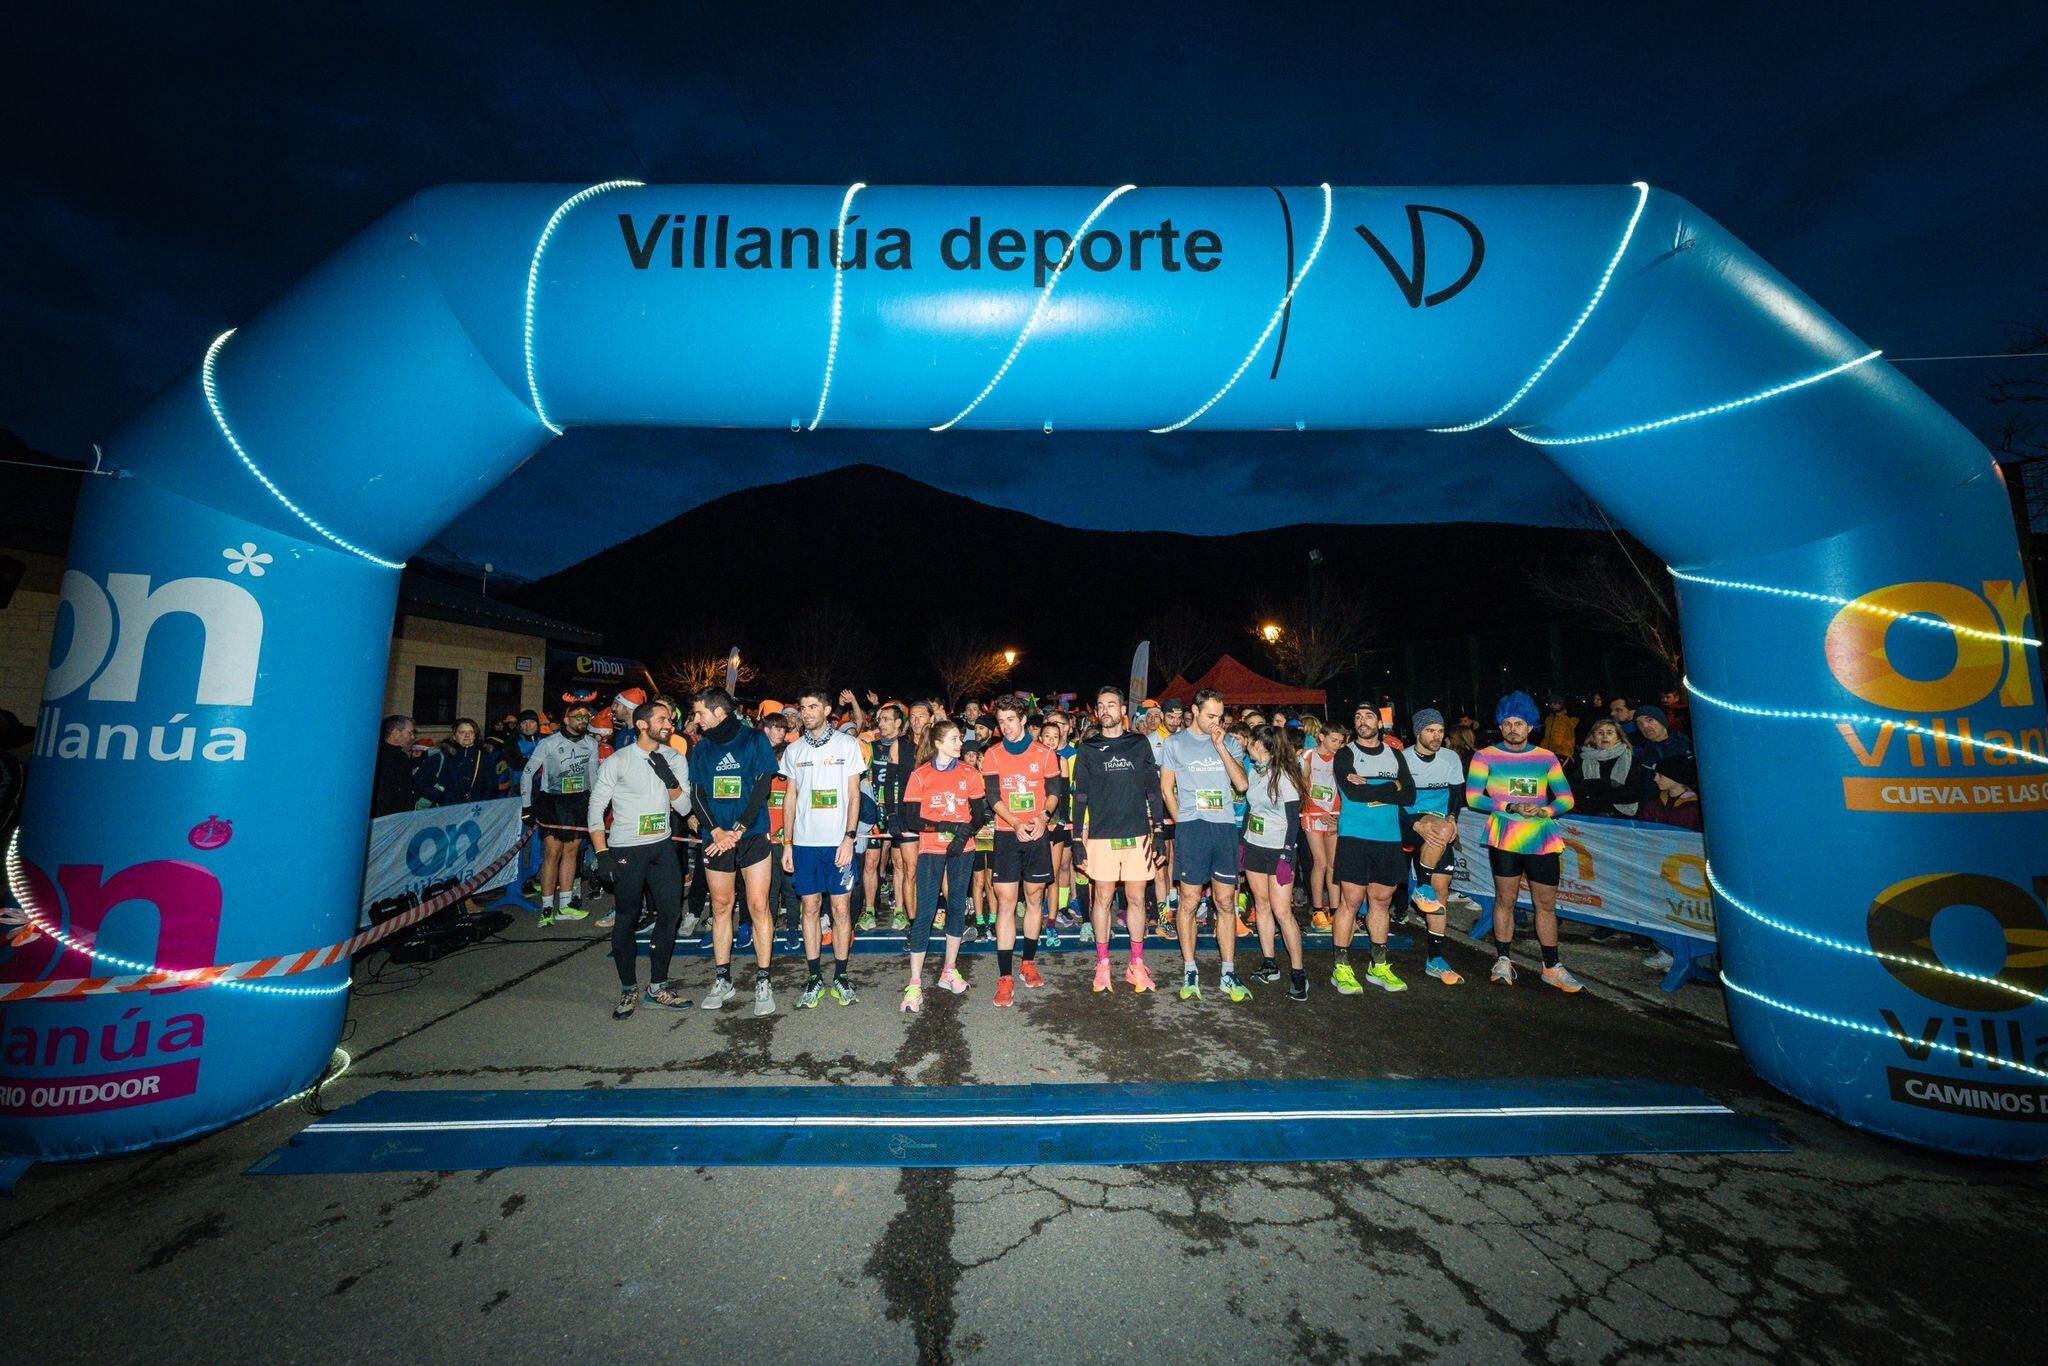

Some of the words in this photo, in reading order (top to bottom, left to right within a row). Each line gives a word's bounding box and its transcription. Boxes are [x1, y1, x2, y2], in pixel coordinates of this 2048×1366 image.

[618, 214, 912, 270] Villanúa
[940, 214, 1223, 288] deporte
[576, 655, 624, 676] embou
[32, 707, 248, 762] illanúa
[1835, 717, 2048, 768] Villan
[716, 763, 741, 771] adidas
[1881, 786, 1968, 805] CUEVA
[1973, 785, 2003, 804] DE
[2008, 783, 2040, 804] LAS
[407, 820, 482, 877] on
[1660, 853, 1714, 899] o
[1866, 872, 2048, 1013] o
[31, 1075, 160, 1108] OUTDOOR
[1905, 1078, 2035, 1115] CAMINOS
